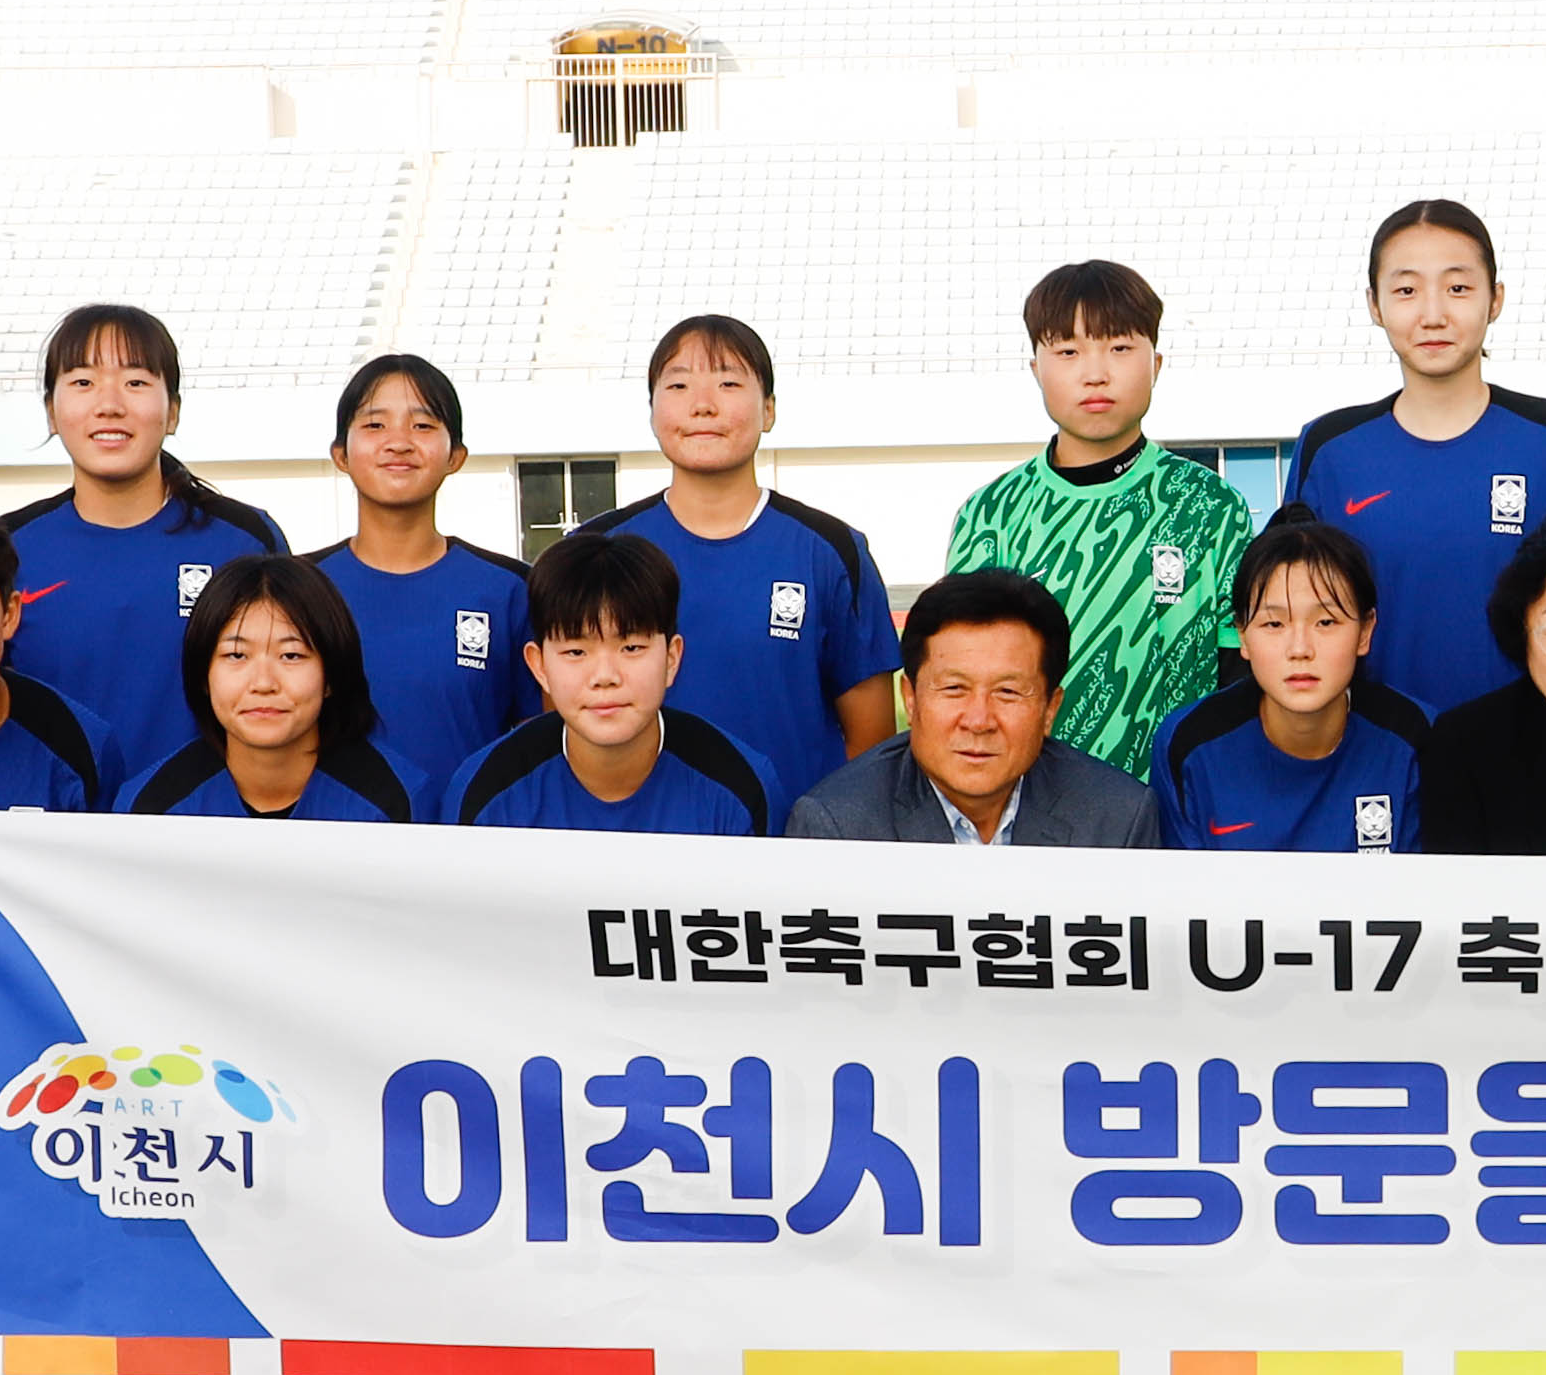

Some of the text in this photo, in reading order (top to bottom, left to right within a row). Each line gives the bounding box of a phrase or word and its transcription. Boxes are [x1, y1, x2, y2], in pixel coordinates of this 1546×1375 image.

[597, 35, 667, 54] N-10
[1491, 523, 1524, 535] KOREA
[770, 627, 800, 640] KOREA
[457, 657, 486, 671] KOREA
[586, 908, 1150, 991] 대한축구협회
[1187, 918, 1423, 993] U-17
[381, 1054, 982, 1247] 이천시
[111, 1186, 196, 1208] Icheon
